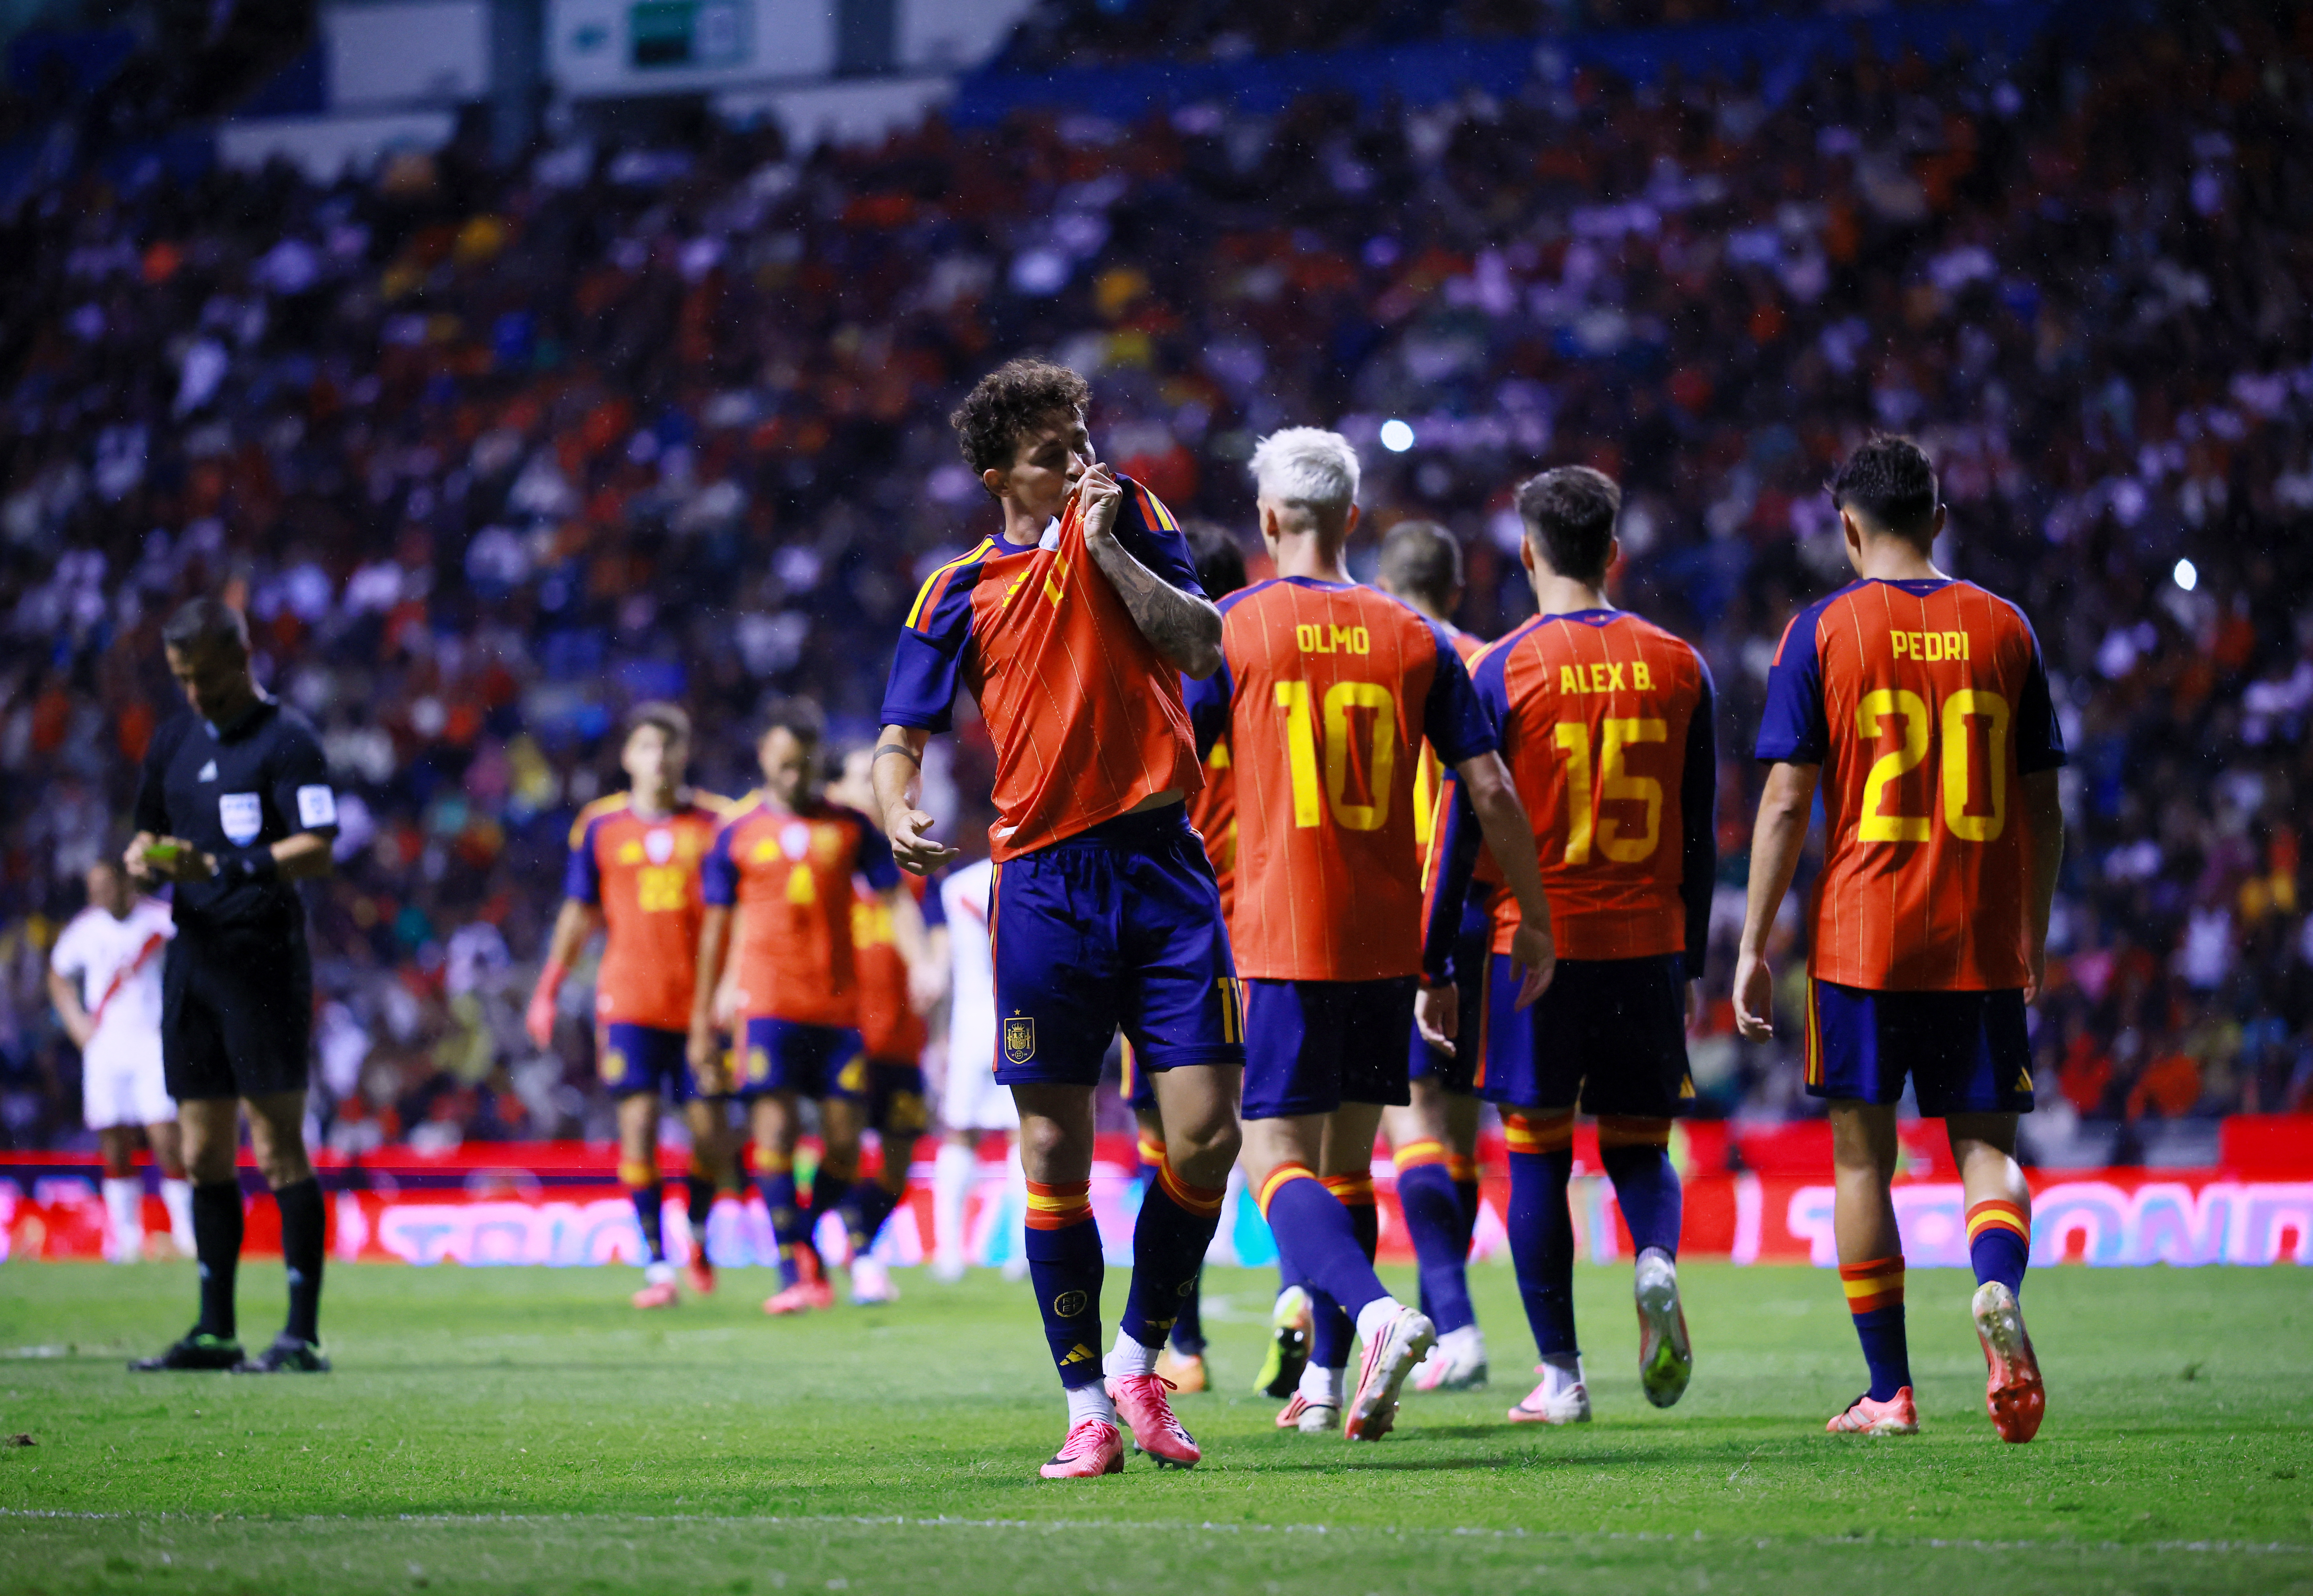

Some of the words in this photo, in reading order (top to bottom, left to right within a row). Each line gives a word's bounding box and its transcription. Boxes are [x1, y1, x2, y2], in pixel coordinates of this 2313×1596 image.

[1295, 623, 1371, 656] OLMO
[1889, 629, 1970, 662] PEDRI
[1559, 661, 1627, 696] ALEX
[1631, 660, 1657, 692] B.
[1273, 679, 1395, 832] 10
[1854, 687, 2008, 844] 20
[1552, 716, 1667, 864] 15
[1217, 977, 1244, 1044] 11
